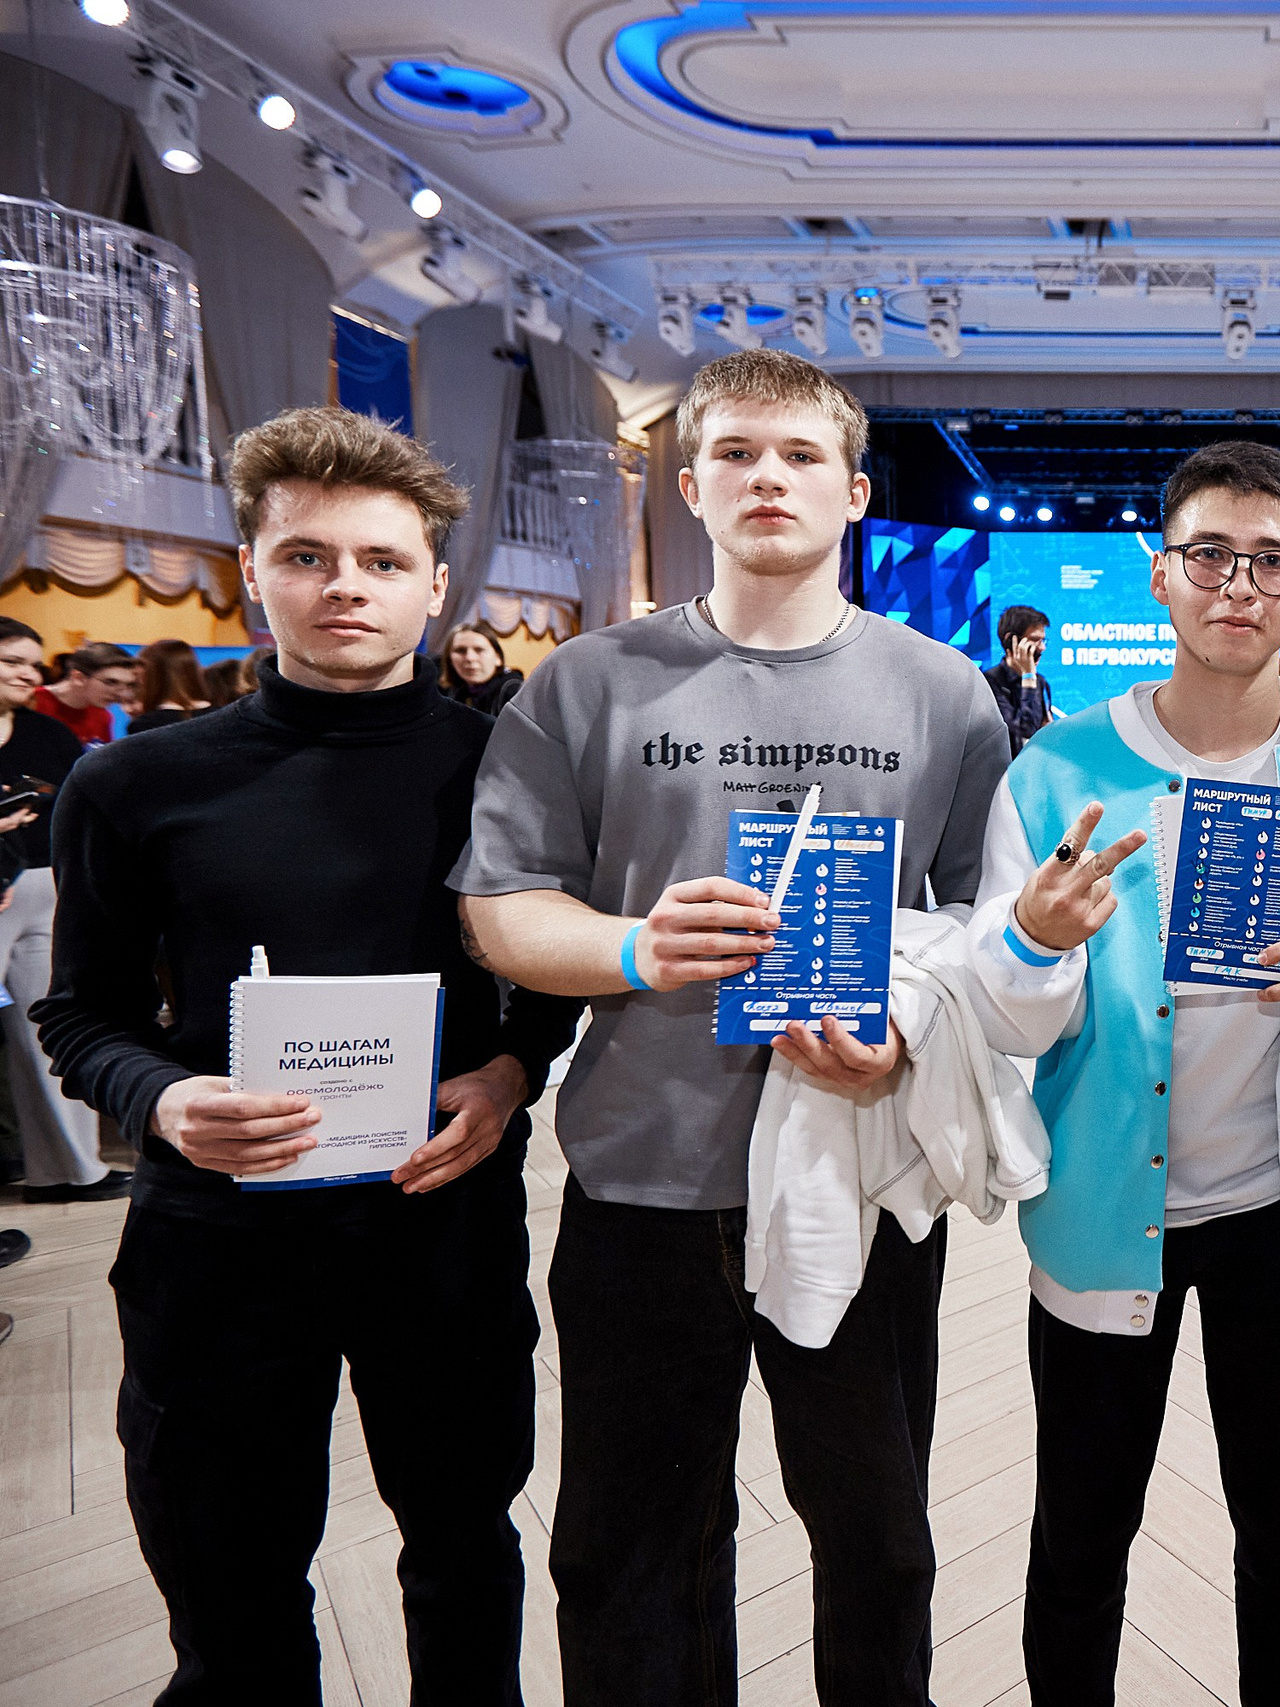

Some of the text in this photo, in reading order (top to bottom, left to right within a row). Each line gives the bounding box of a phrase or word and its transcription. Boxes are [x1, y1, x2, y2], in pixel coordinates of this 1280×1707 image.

[1061, 623, 1157, 641] ОБЛАСТНОЕ
[1061, 648, 1074, 665] В
[642, 731, 901, 774] the simpsons
[1193, 788, 1271, 805] МАРШРУТНЫЙ
[1193, 802, 1223, 814] ЛИСТ
[739, 823, 828, 835] МАРШРУЫЙ
[739, 837, 774, 847] ЛИСТ
[1214, 941, 1247, 951] Отрывная
[775, 992, 813, 1000] Отрывная
[284, 1038, 390, 1054] ПО ШАГАМ
[279, 1054, 394, 1070] МЕДИЦИНЫ
